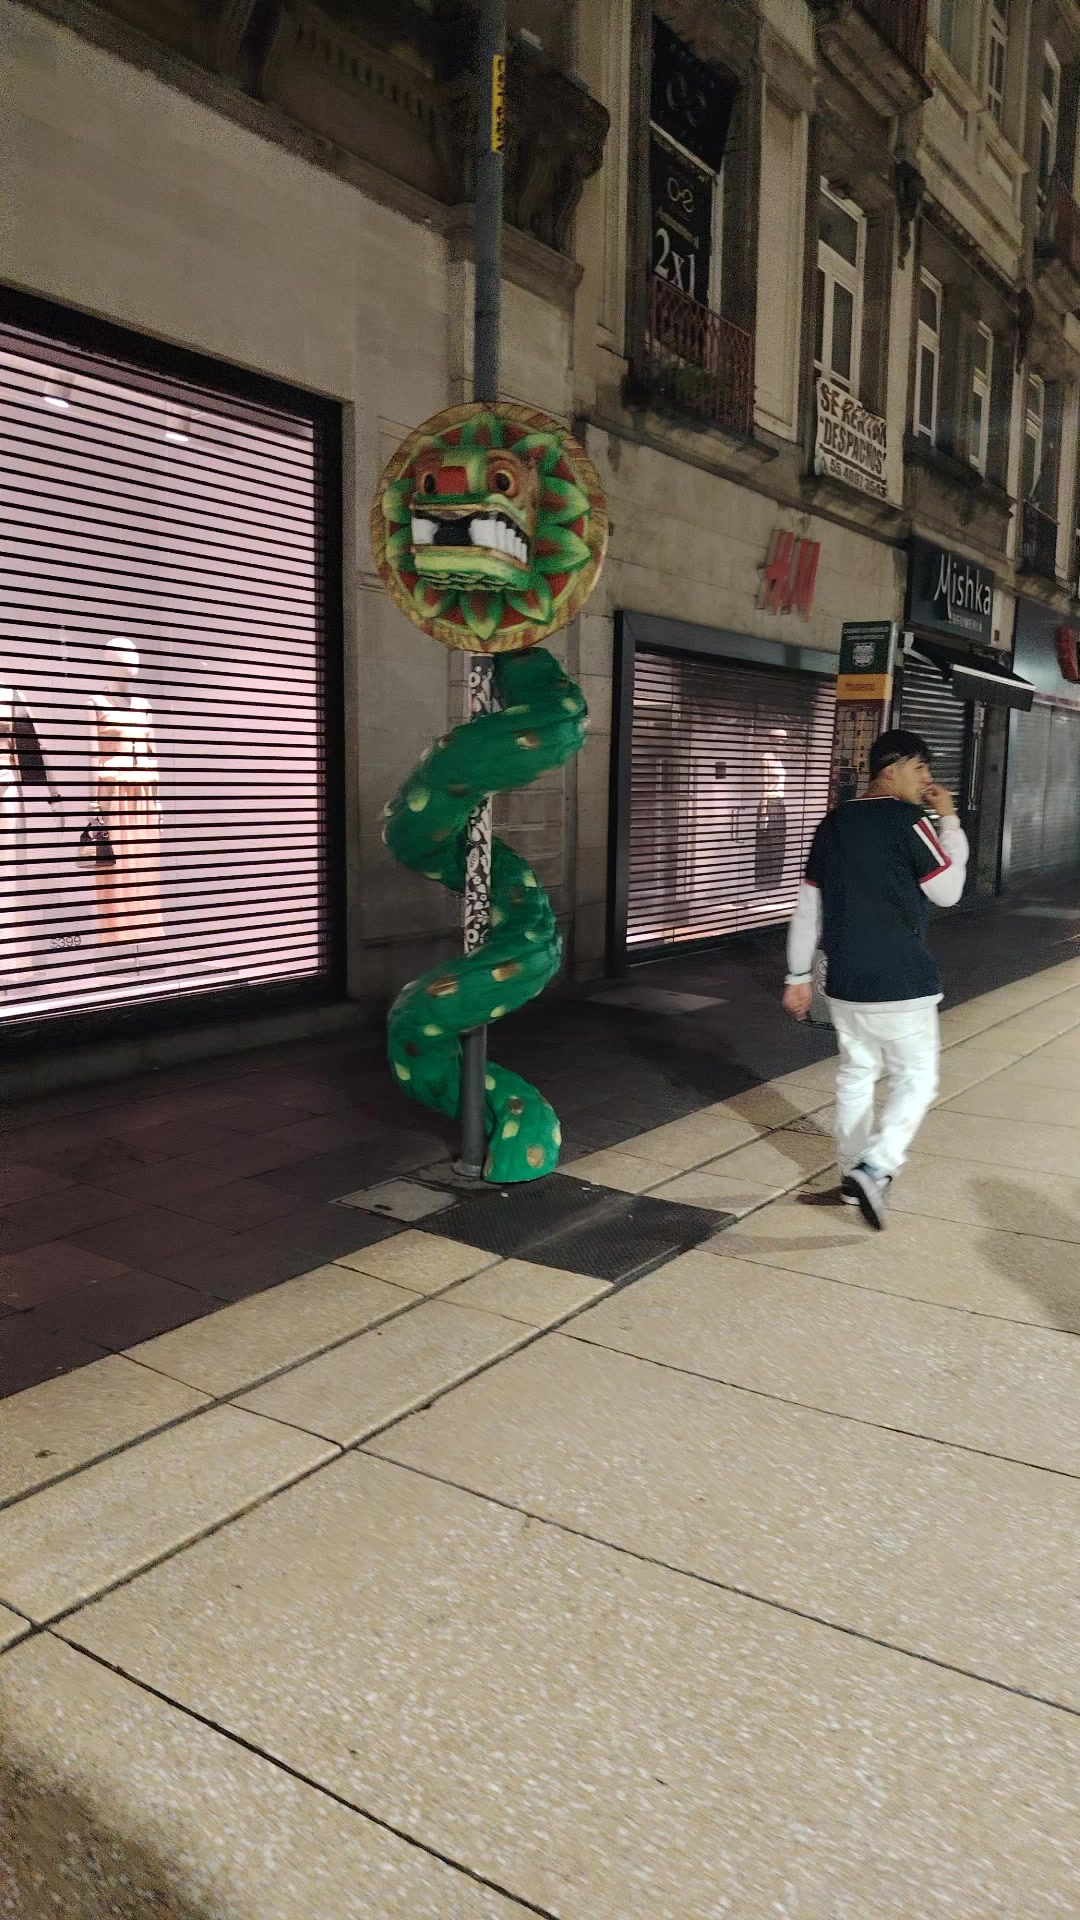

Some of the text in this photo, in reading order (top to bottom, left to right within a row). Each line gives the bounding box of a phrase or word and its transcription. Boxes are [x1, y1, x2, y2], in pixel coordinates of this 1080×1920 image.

[821, 383, 886, 448] SE RENTAN
[830, 459, 841, 476] 55
[934, 553, 991, 621] Mishka
[50, 935, 81, 948] $399
